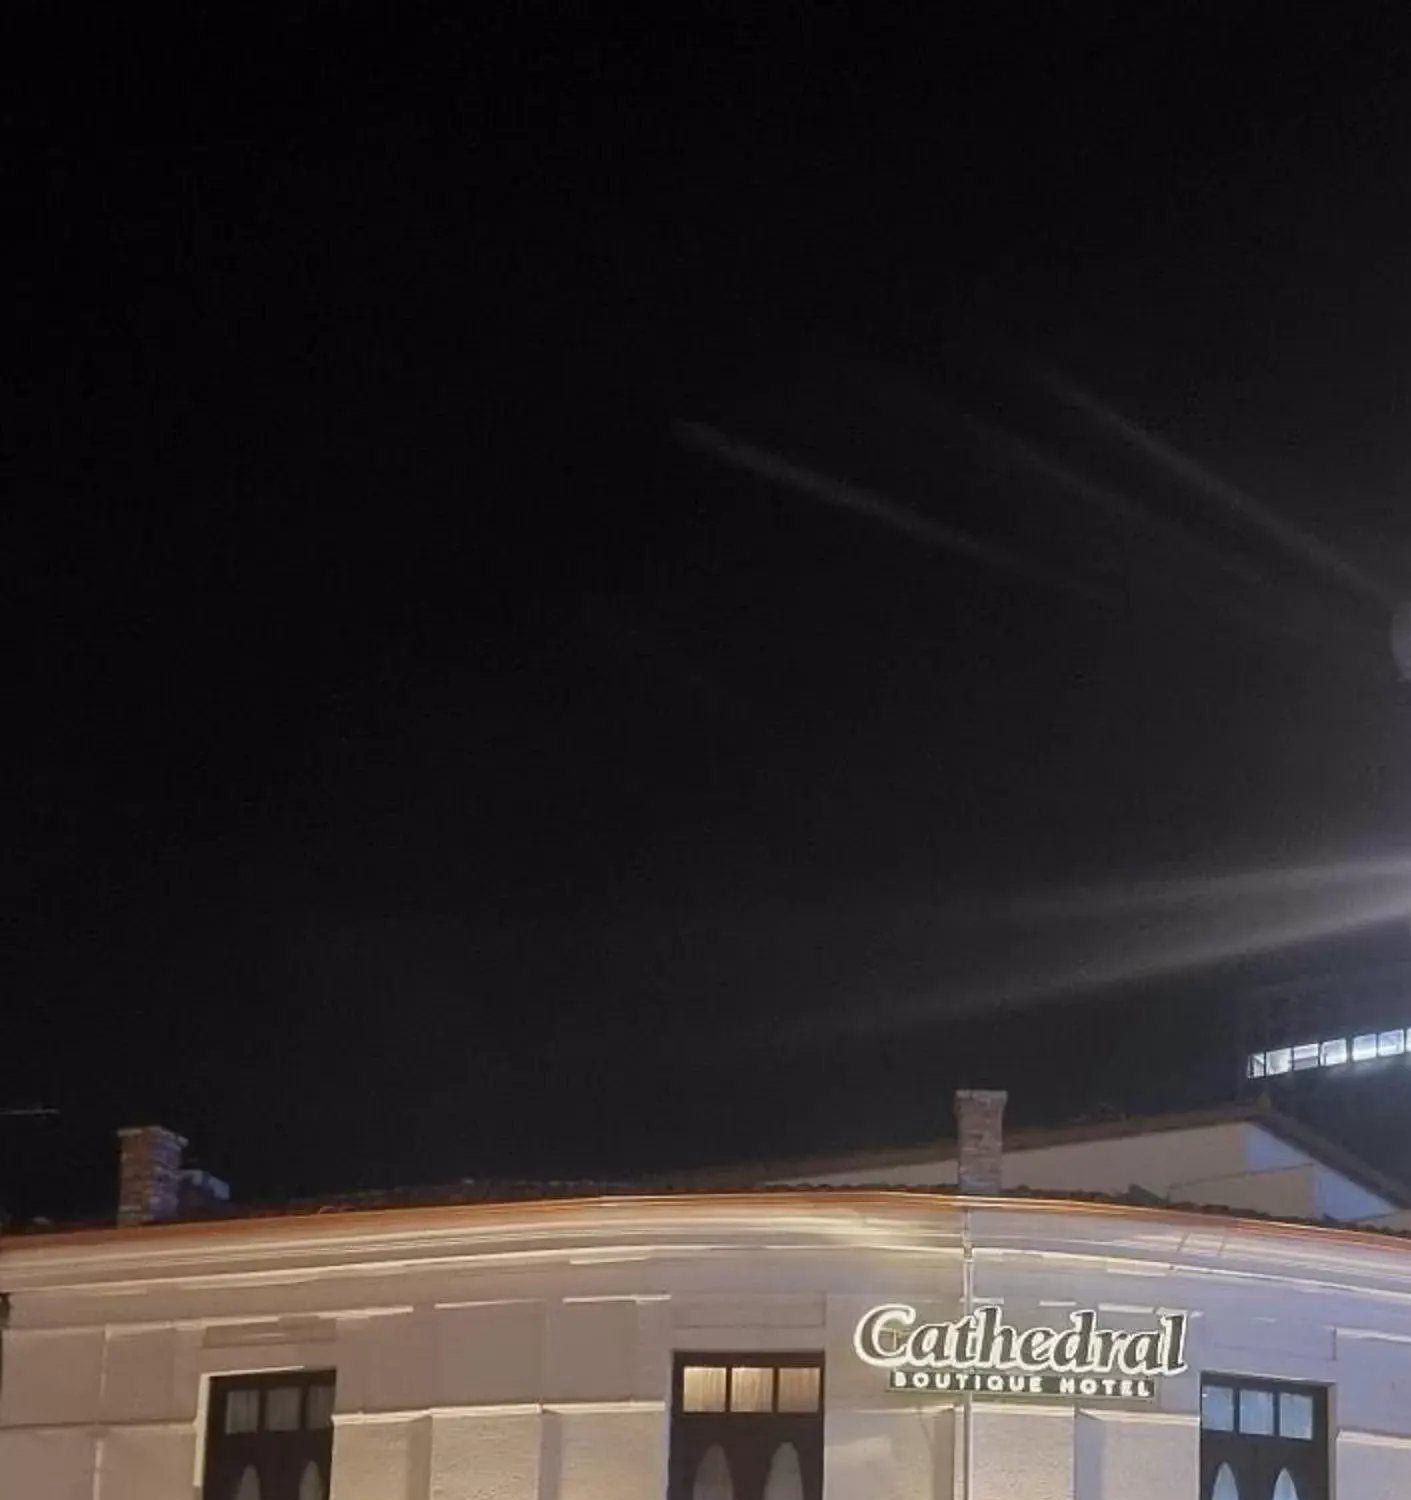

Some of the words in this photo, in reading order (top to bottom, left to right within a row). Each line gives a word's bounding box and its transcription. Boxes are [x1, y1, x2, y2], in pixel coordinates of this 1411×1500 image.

[853, 1303, 1188, 1376] Cathedral
[894, 1372, 1043, 1393] BOUTIQUE
[1058, 1377, 1150, 1397] HOTEL
